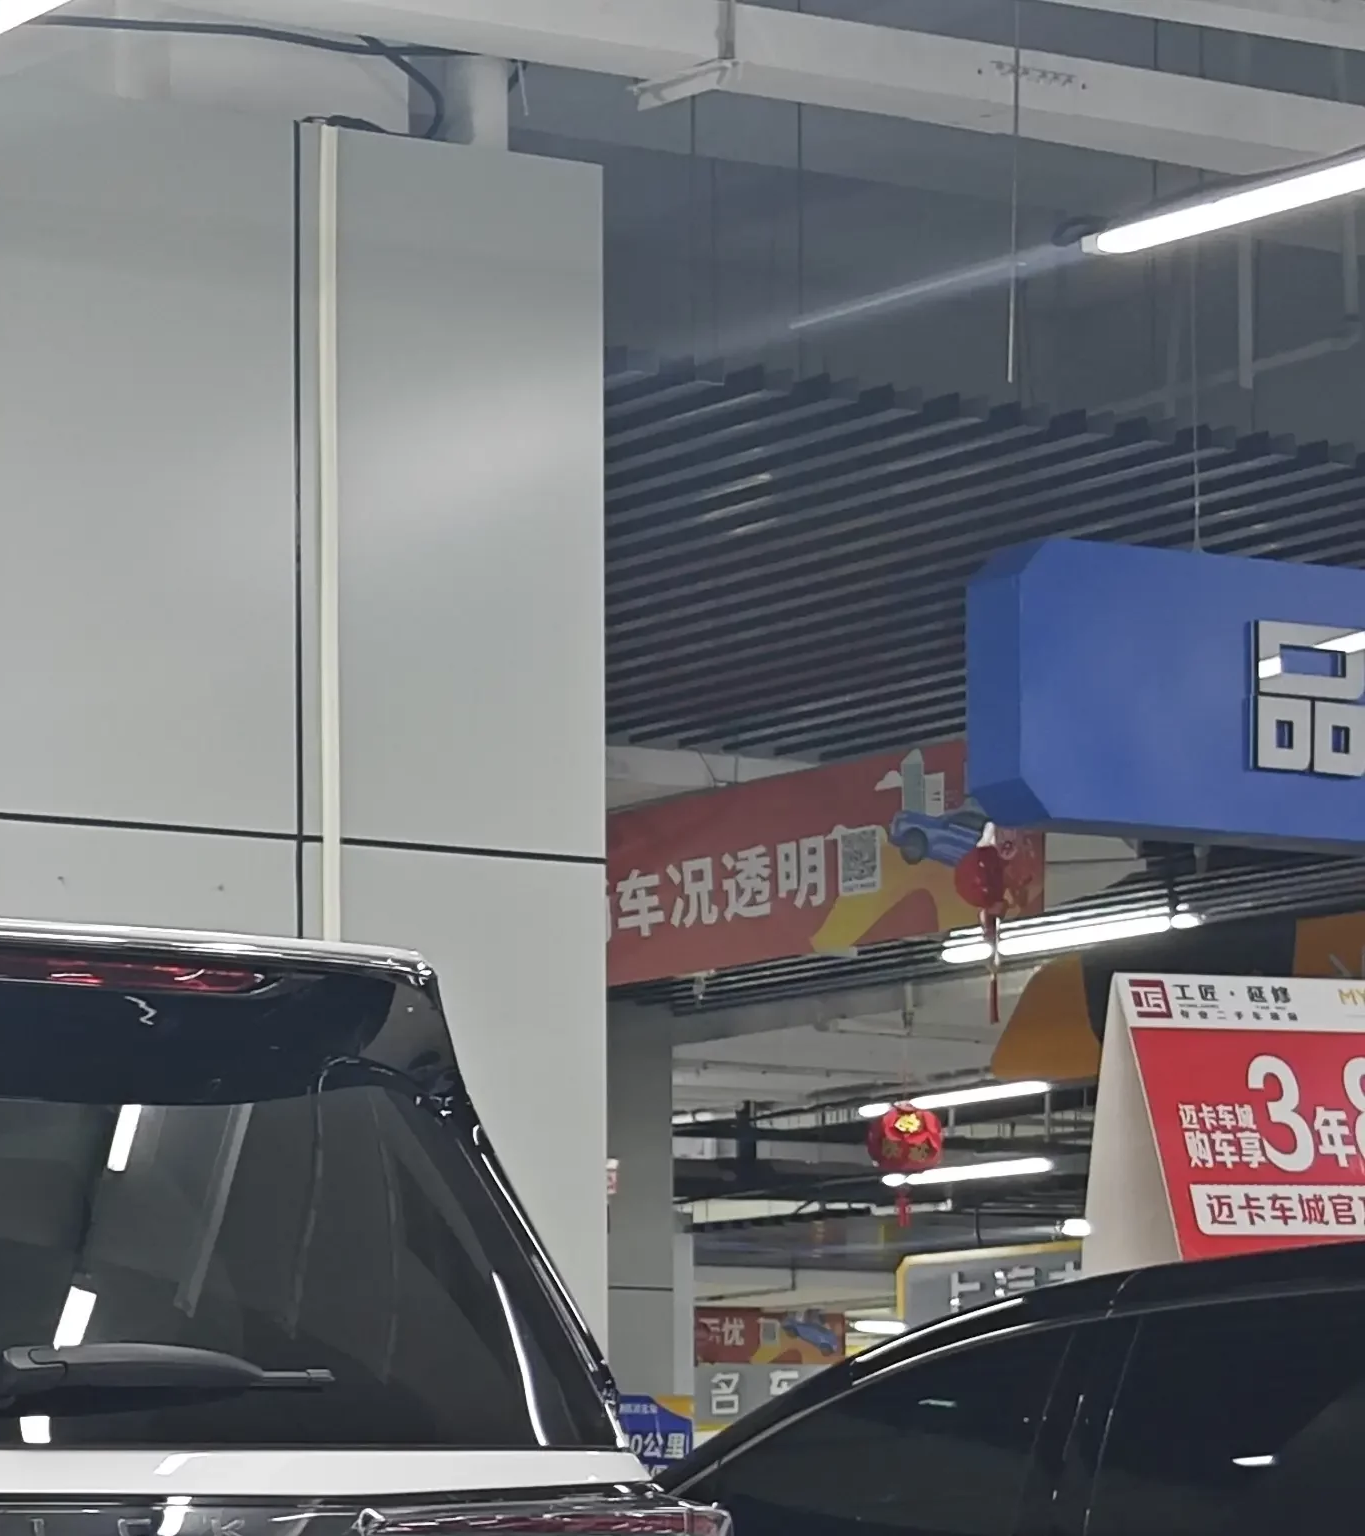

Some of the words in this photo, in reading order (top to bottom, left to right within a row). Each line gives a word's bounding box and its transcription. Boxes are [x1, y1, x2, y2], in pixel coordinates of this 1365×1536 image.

[1254, 618, 1365, 777] 品
[606, 835, 827, 942] 车况透明
[1177, 1102, 1258, 1131] 迈卡车城
[1183, 1131, 1268, 1170] 购车享
[1205, 1191, 1365, 1228] 迈卡车城官
